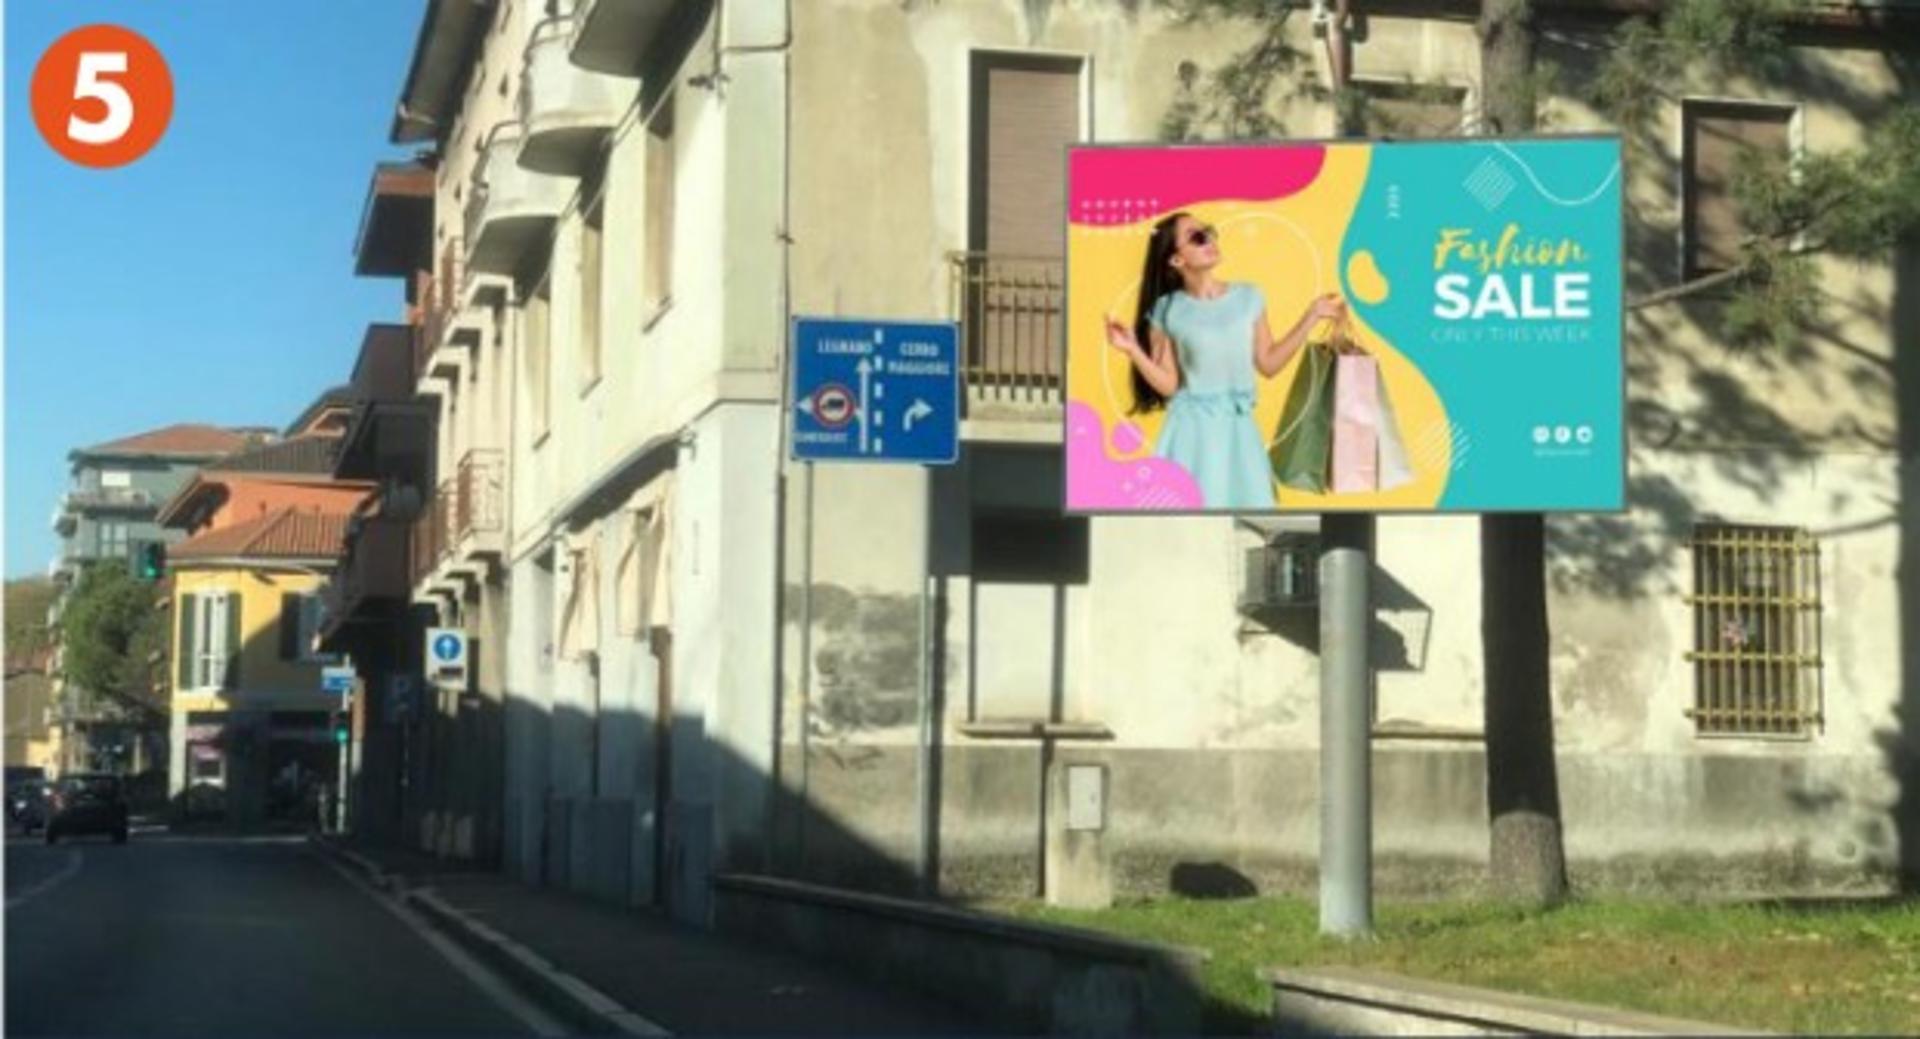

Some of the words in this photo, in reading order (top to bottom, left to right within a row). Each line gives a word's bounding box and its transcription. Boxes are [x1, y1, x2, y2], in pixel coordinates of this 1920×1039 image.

[1434, 222, 1588, 274] Fashion
[1434, 273, 1591, 319] SALE
[1431, 326, 1485, 343] ONLY
[1490, 326, 1532, 343] THIS
[1535, 326, 1590, 343] WEEK
